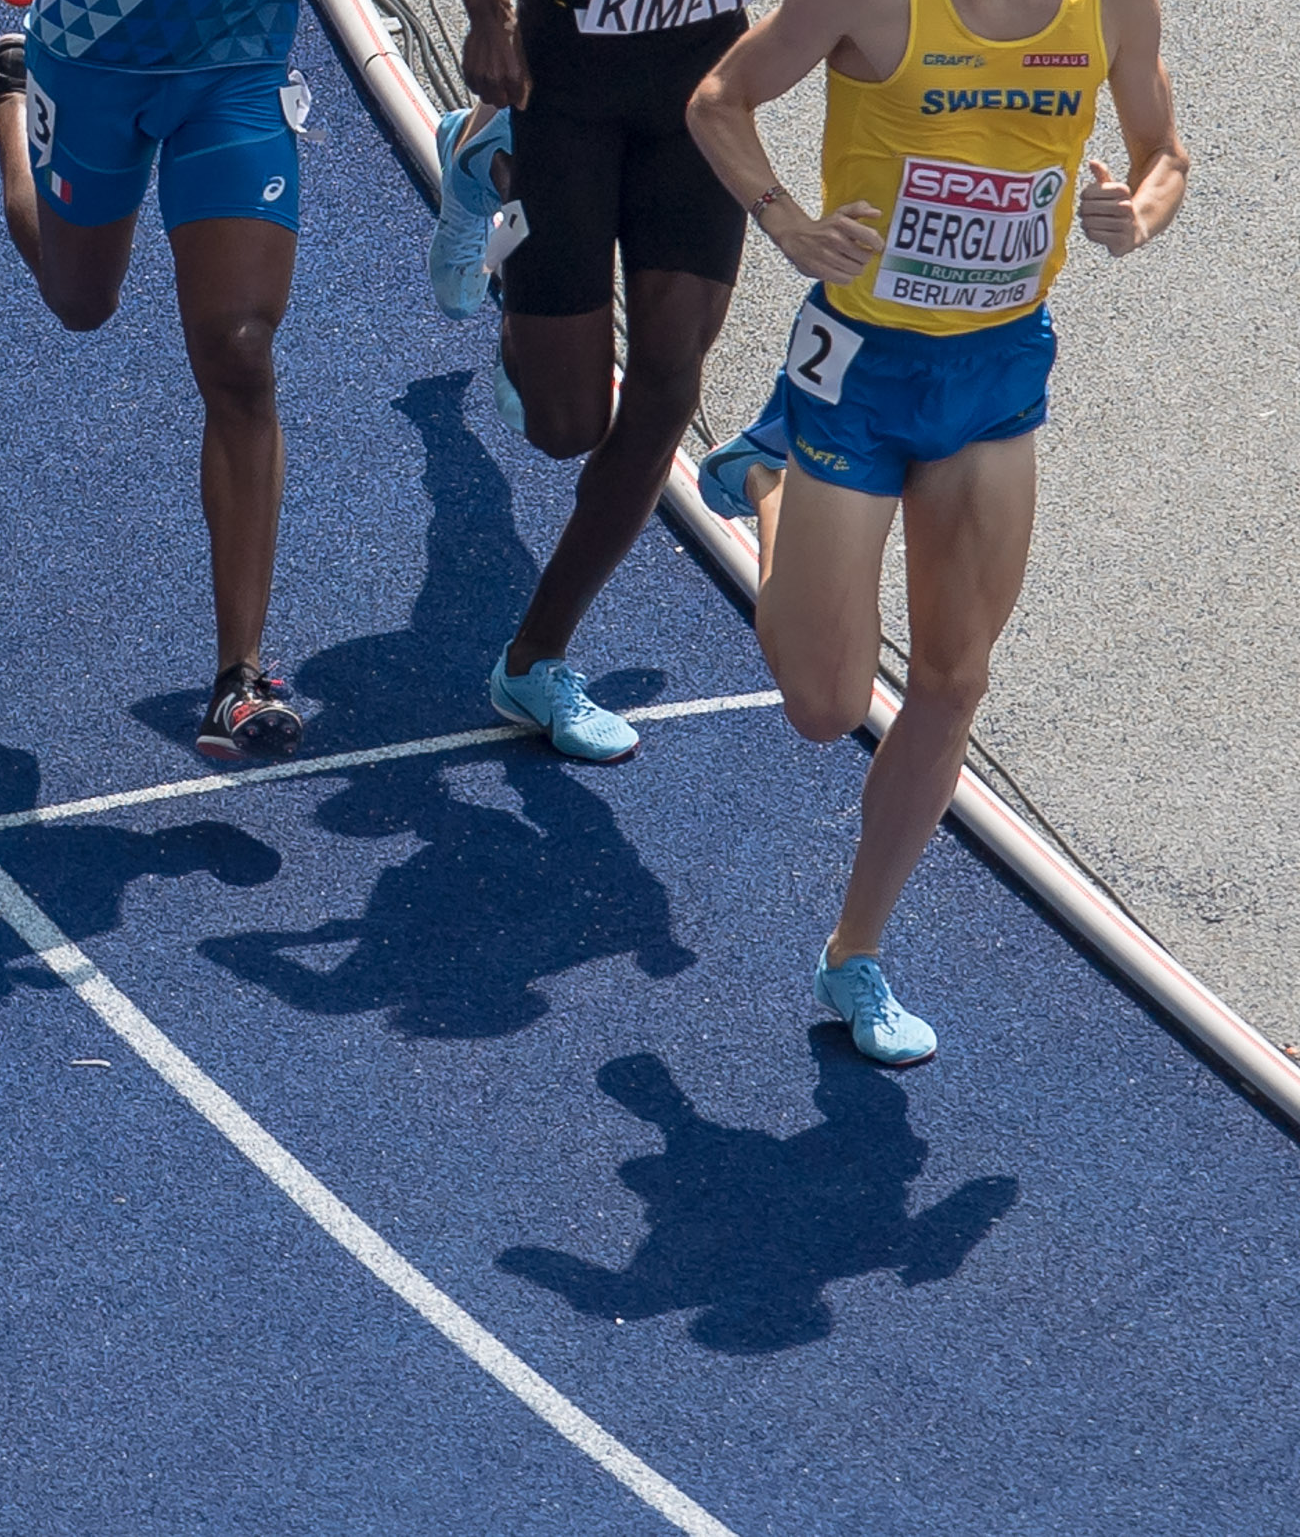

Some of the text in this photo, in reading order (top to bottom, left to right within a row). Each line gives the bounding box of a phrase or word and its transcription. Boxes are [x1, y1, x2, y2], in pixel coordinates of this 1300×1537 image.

[1023, 54, 1088, 66] BAUHAUS
[34, 94, 51, 144] 3
[921, 89, 1082, 116] SWEDEN
[909, 168, 1030, 208] SPAR
[895, 205, 1049, 264] BERGLUND
[930, 265, 964, 280] RUN
[893, 277, 1027, 307] BERLIN 2018
[797, 324, 832, 386] 2
